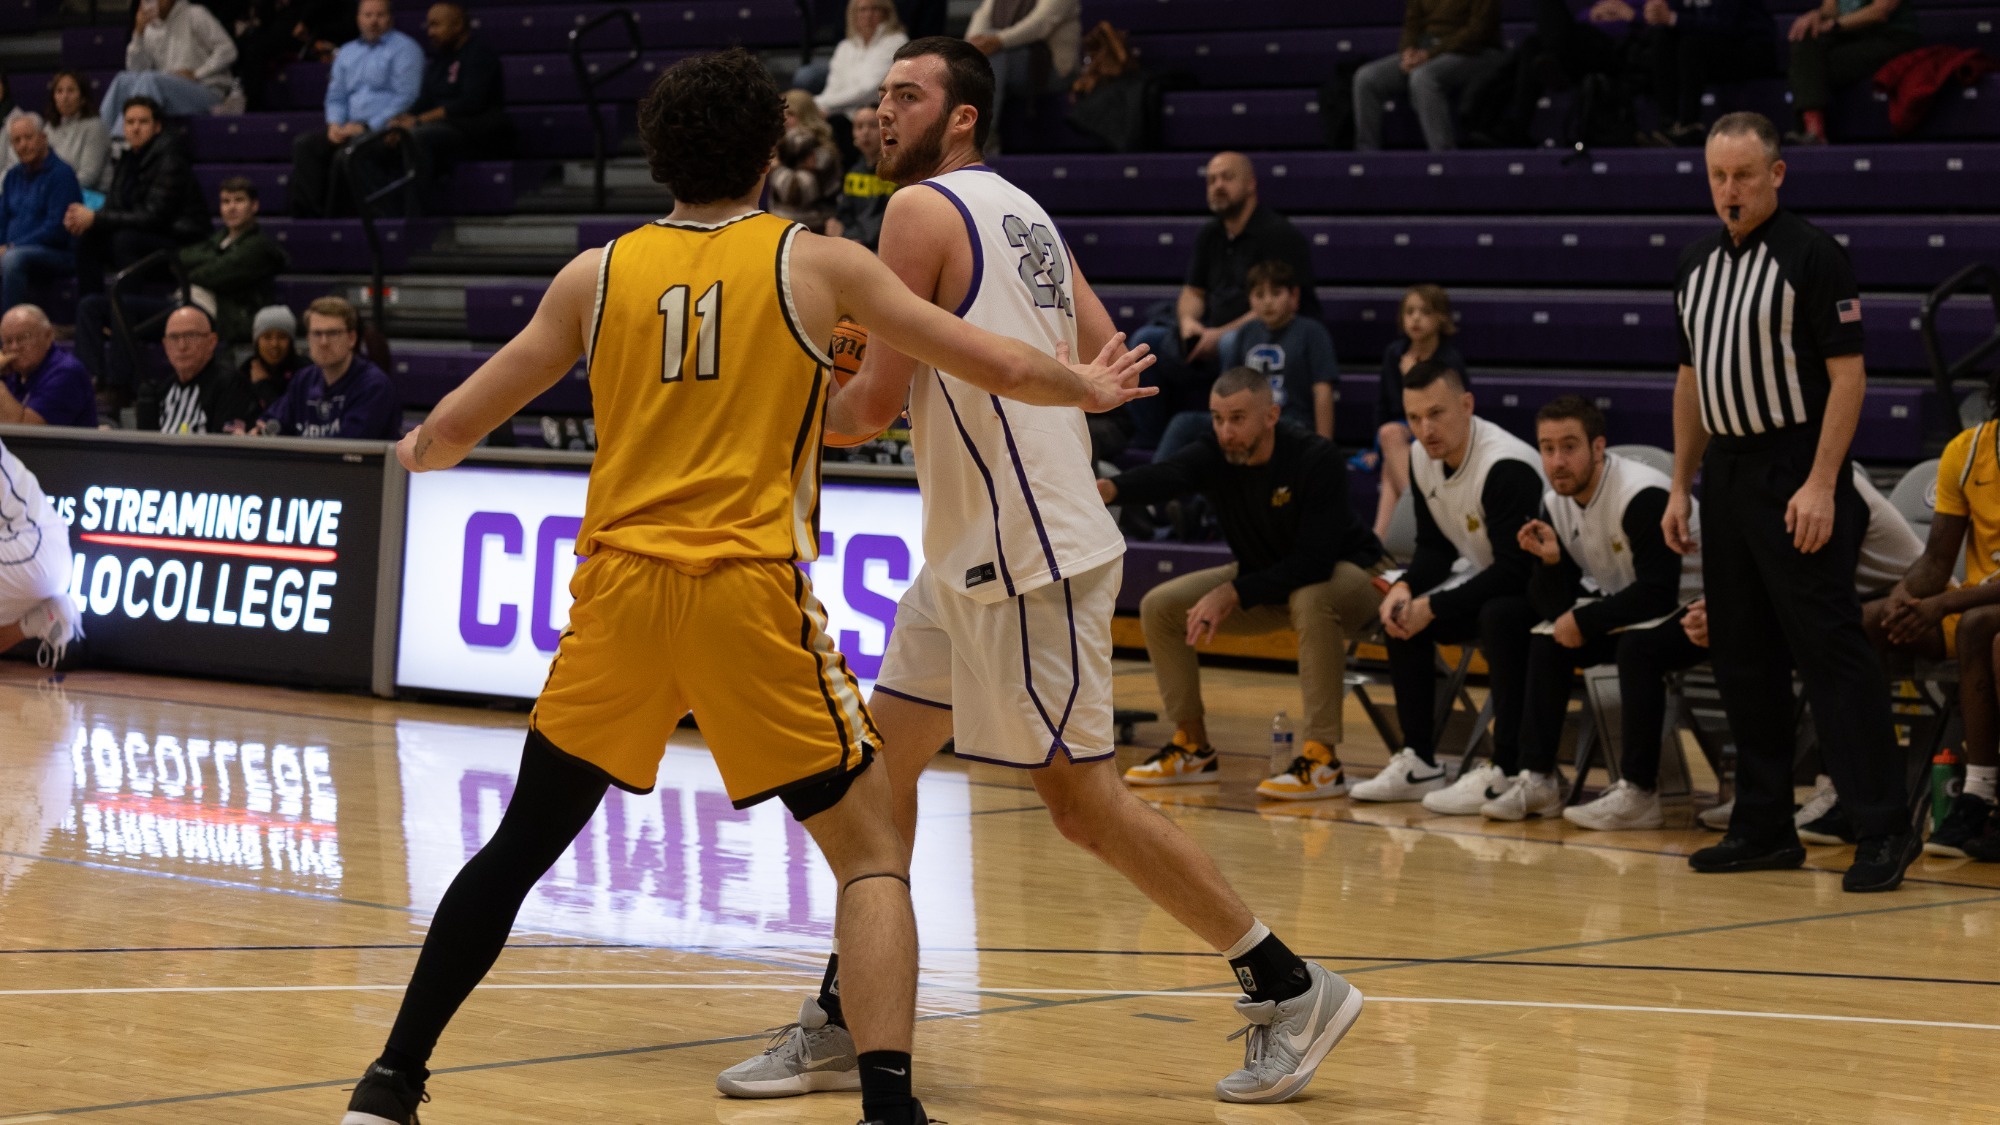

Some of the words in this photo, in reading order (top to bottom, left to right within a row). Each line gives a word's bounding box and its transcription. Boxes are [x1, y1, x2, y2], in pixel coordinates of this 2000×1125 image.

[1002, 214, 1074, 318] 22
[657, 280, 723, 383] 11
[58, 496, 77, 526] IS
[81, 485, 262, 541] STREAMING
[266, 498, 343, 547] LIVE
[71, 552, 338, 633] LOCOLLEGE
